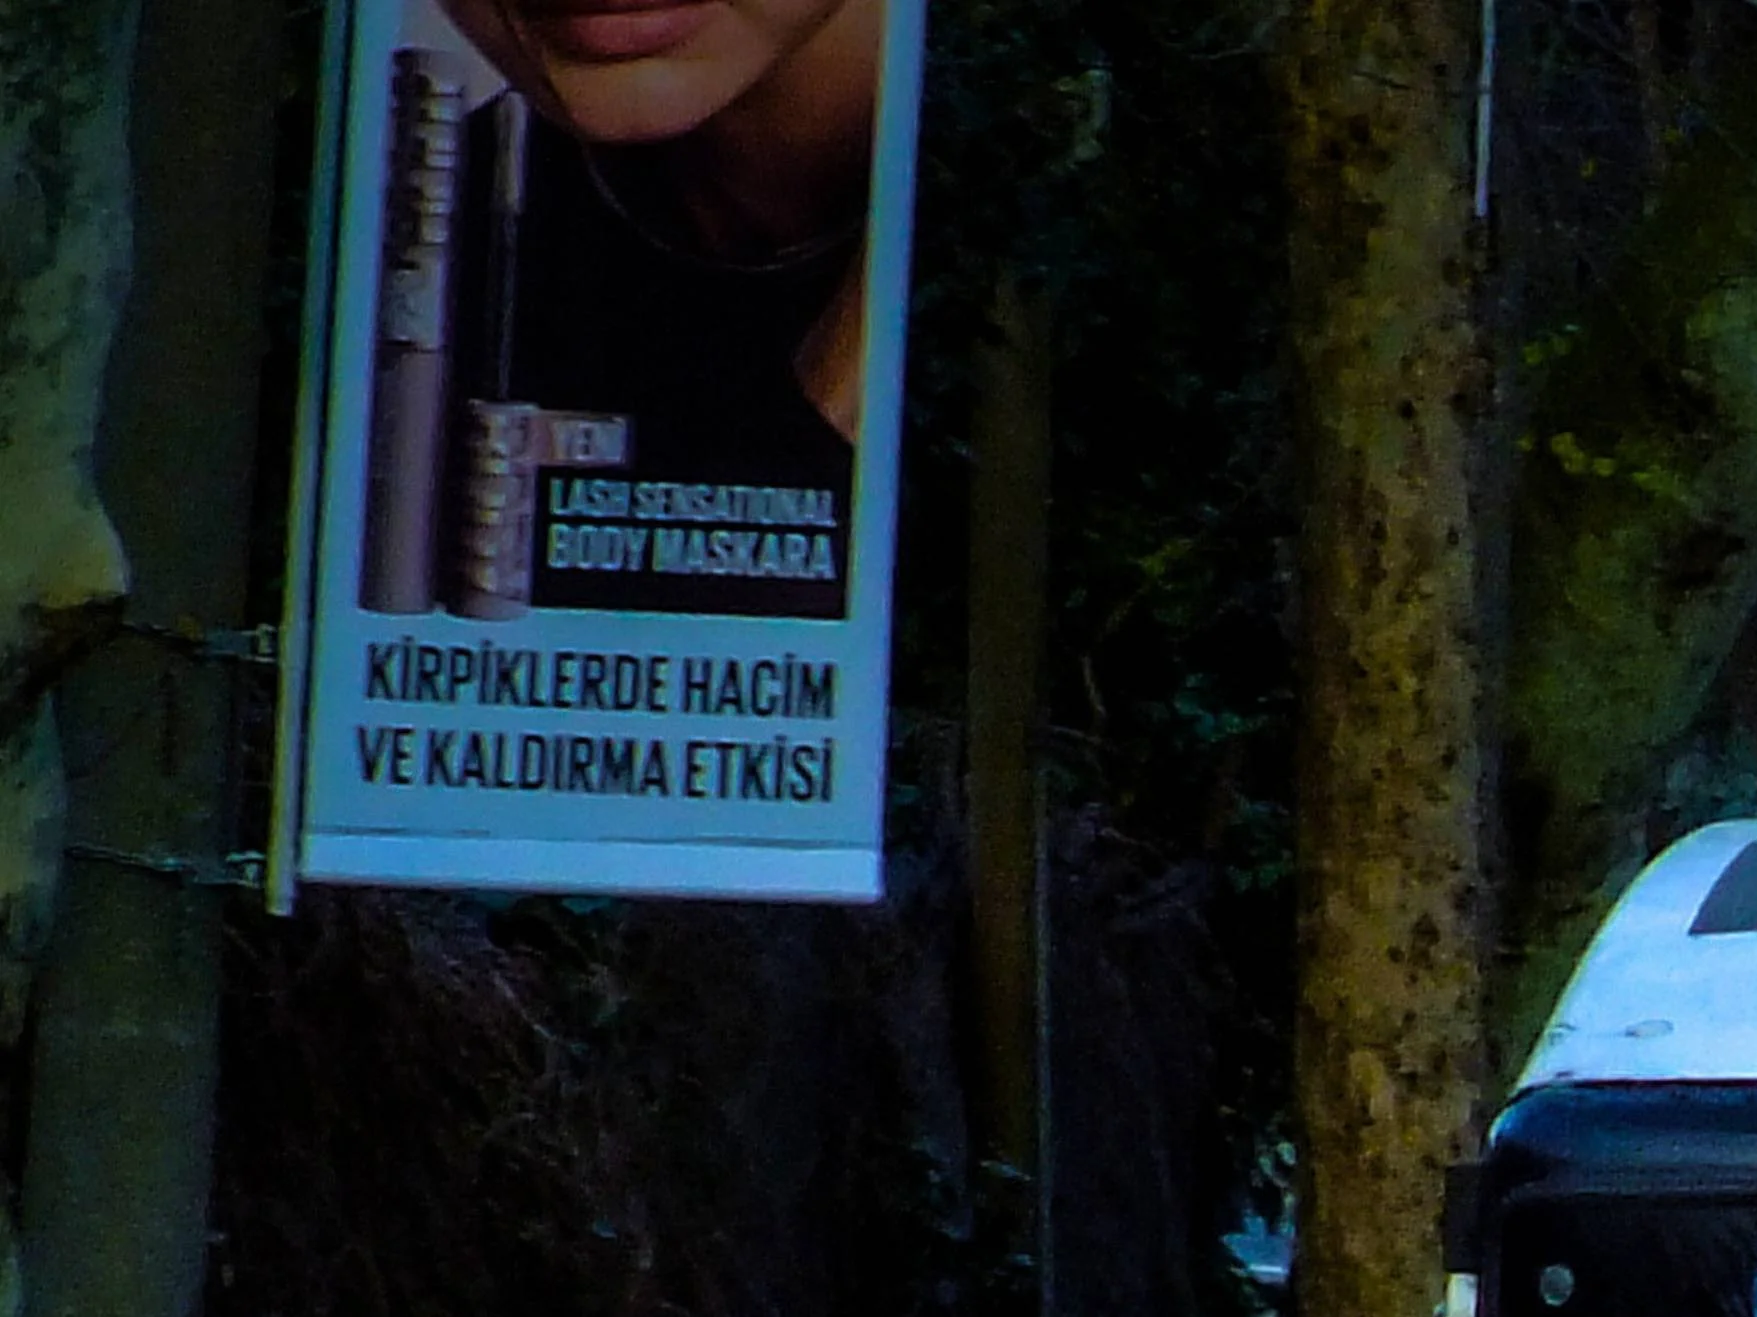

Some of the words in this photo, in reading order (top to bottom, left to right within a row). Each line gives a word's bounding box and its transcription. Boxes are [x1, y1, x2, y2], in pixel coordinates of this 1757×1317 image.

[548, 522, 648, 572] BODY
[652, 527, 837, 580] MASKARA
[366, 635, 669, 713] KİRPİKLERDE
[683, 652, 838, 720] HACİM
[357, 724, 416, 785] VE
[427, 726, 670, 797] KALDIRMA
[685, 733, 836, 803] ETKİSİ
